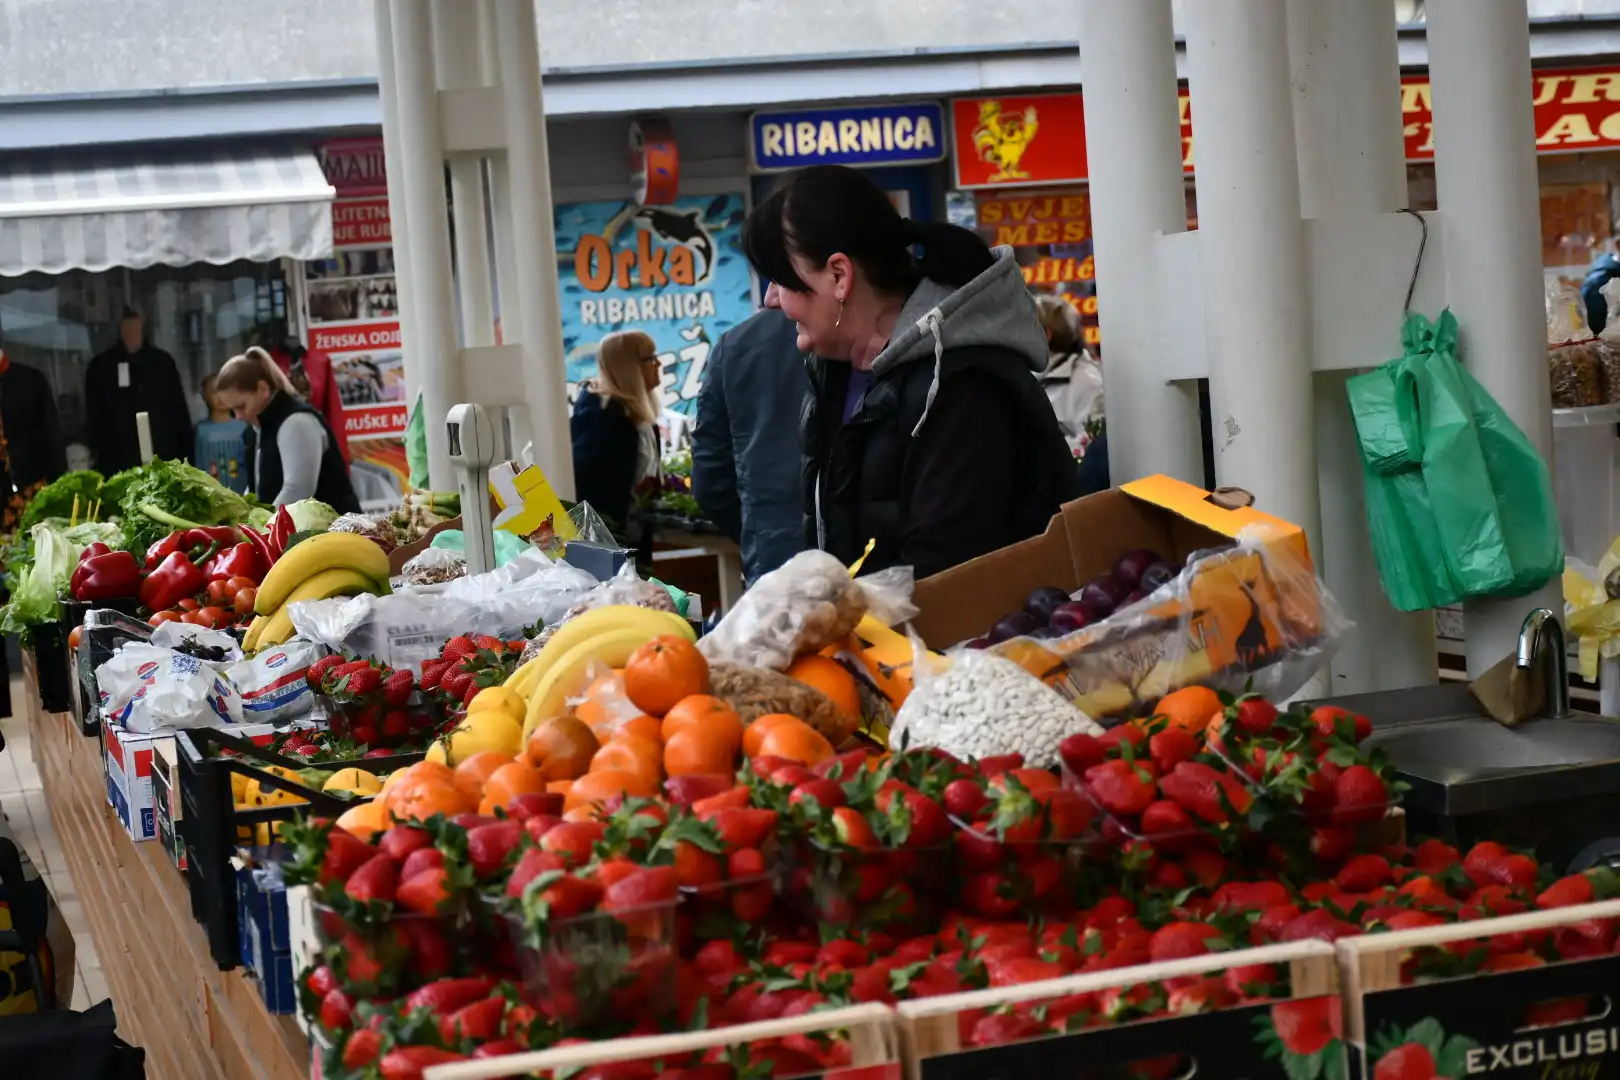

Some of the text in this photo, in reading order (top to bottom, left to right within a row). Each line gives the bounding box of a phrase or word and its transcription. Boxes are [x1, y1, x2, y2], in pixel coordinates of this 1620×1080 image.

[762, 116, 935, 157] RIBARNICA
[333, 204, 389, 223] LITETN
[980, 196, 1084, 224] SVJE
[574, 229, 696, 293] Orka
[580, 291, 716, 325] RIBARNICA
[315, 333, 367, 349] ŽENSKA
[1466, 1028, 1618, 1075] EXCLUSI
